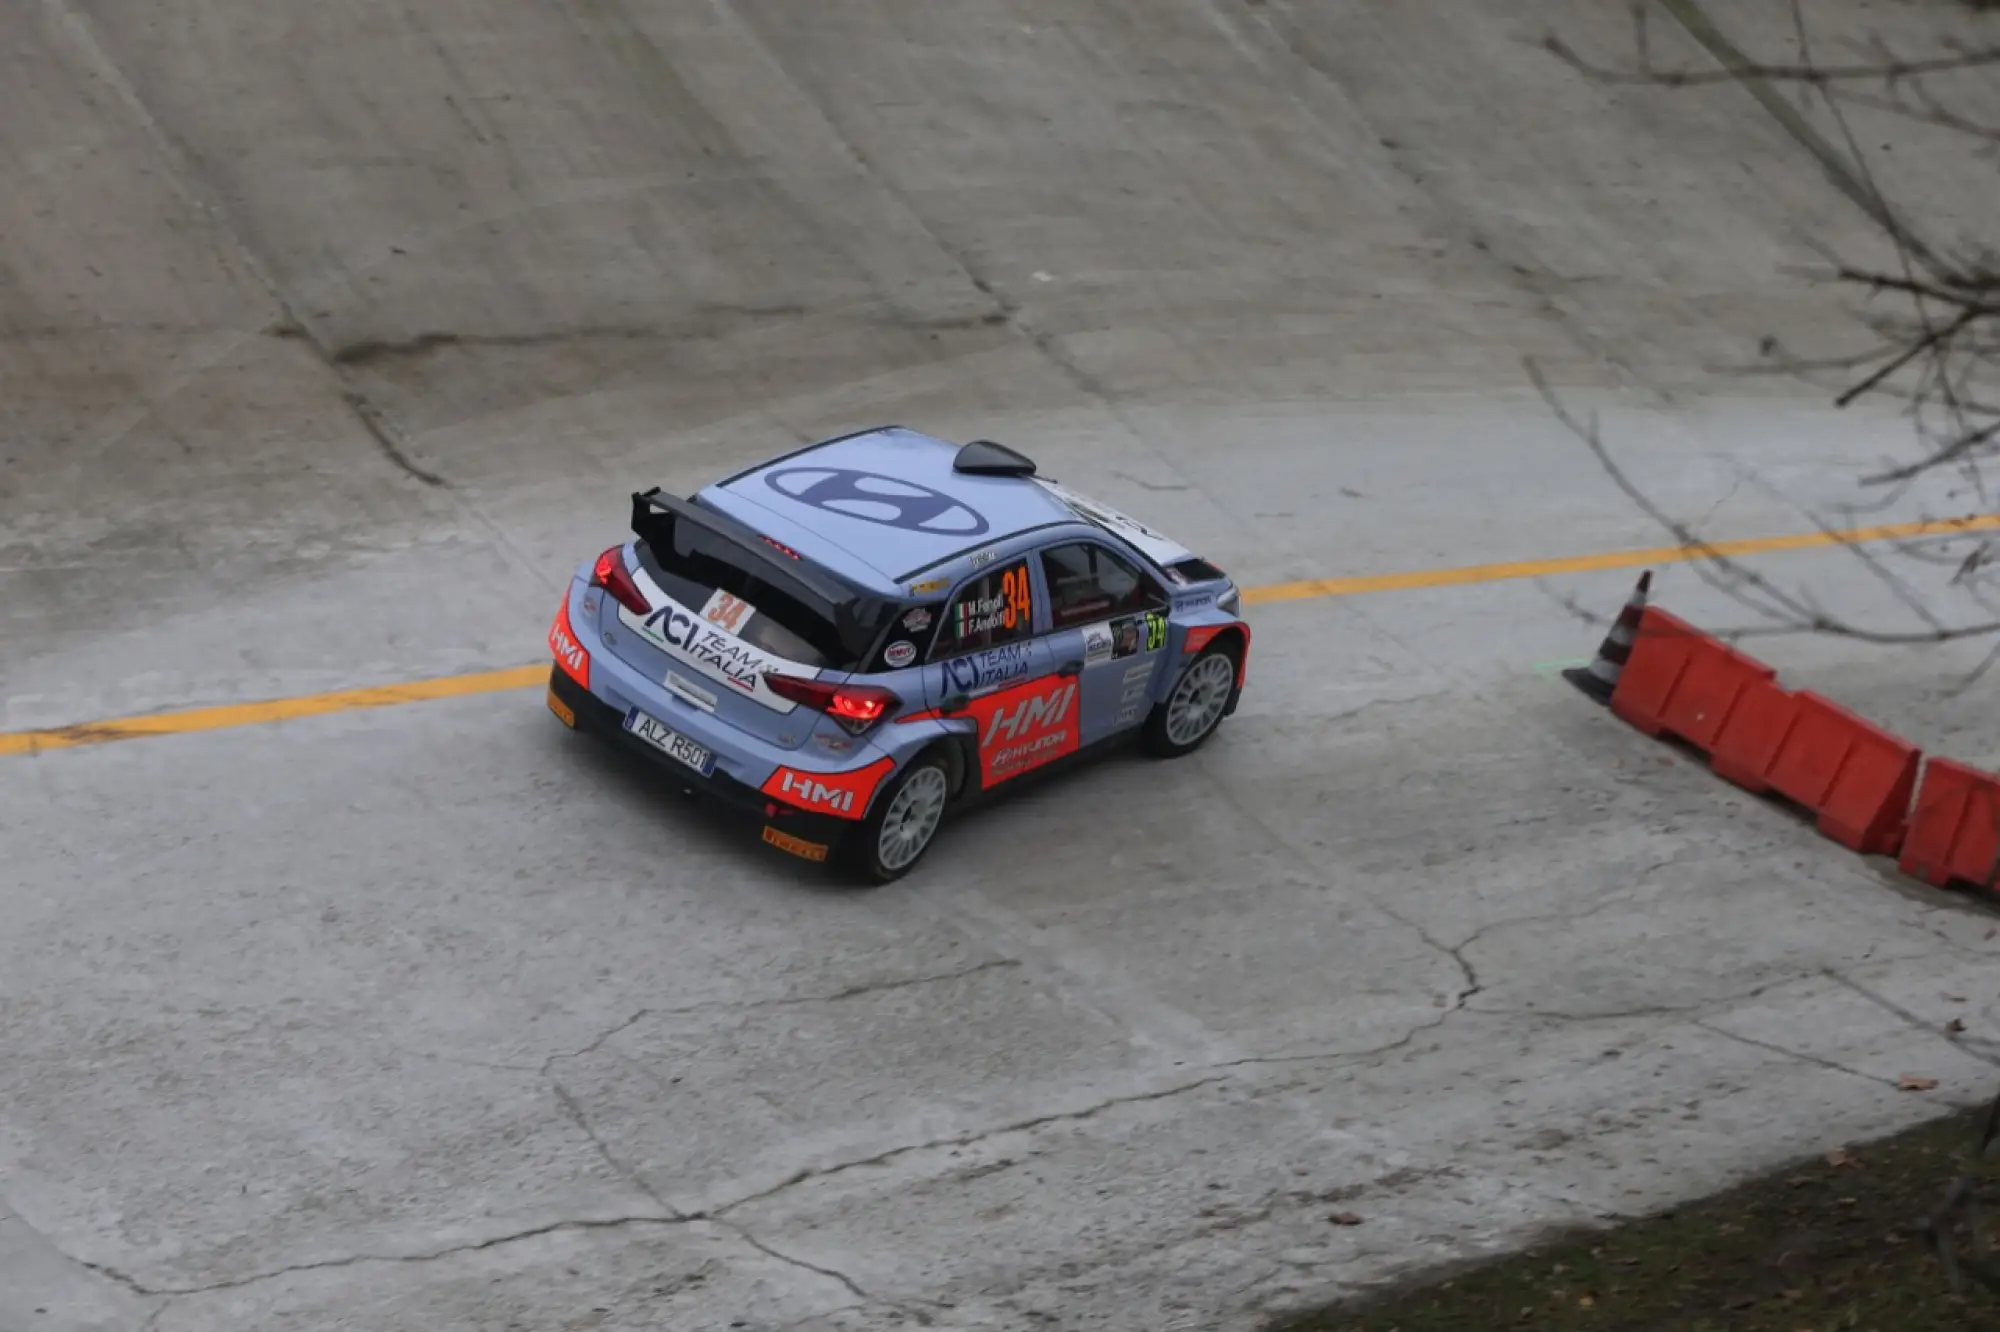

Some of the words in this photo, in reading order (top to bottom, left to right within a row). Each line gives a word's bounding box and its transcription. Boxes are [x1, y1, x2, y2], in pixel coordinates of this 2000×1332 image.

[708, 594, 747, 631] 34
[1002, 566, 1030, 629] 34
[551, 624, 584, 670] HMI
[644, 605, 699, 651] ACI
[1147, 612, 1165, 652] 34
[689, 643, 757, 688] ITALIA
[702, 631, 763, 668] TEAM
[980, 644, 1021, 668] TEAM
[941, 656, 979, 698] ACI
[980, 661, 1028, 687] ITALIA
[981, 684, 1076, 748] HMI
[639, 719, 671, 748] ALZ
[670, 735, 709, 769] R501
[781, 772, 854, 811] HMI
